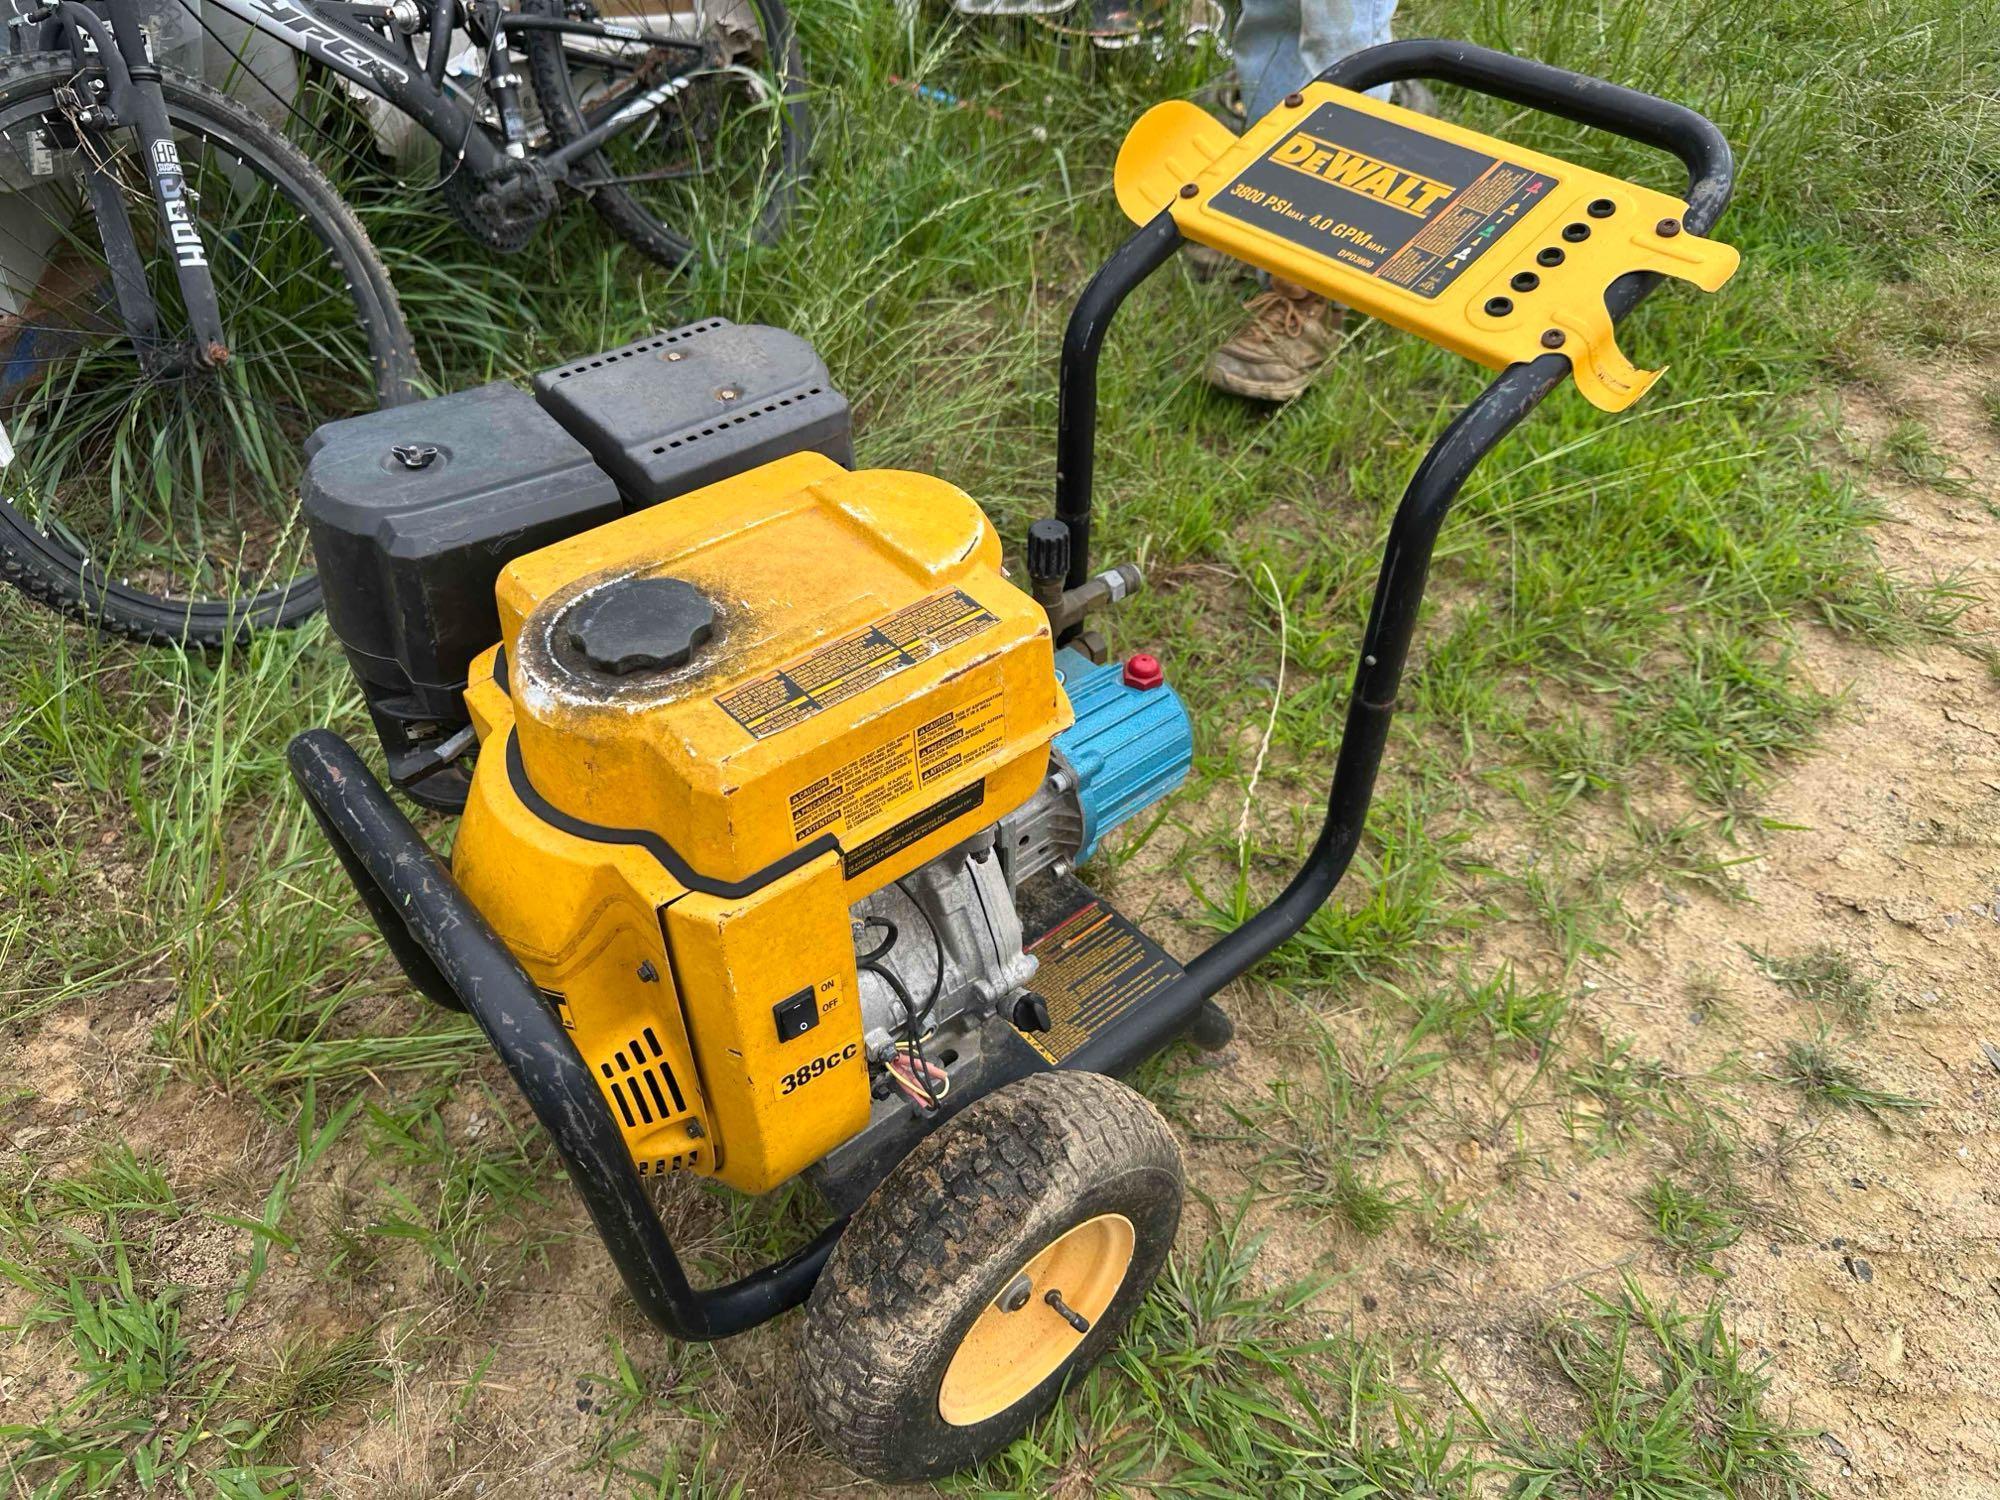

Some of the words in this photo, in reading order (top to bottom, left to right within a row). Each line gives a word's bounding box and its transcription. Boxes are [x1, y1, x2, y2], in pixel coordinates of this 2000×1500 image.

[1274, 138, 1453, 213] DEWALT
[1230, 183, 1265, 204] 3800
[1308, 214, 1334, 231] 4.0
[925, 714, 952, 731] CAUTION
[931, 755, 960, 776] ATTENTION
[799, 778, 828, 799] CAUTION
[805, 811, 840, 836] ATTENTION
[820, 980, 834, 992] ON
[822, 998, 838, 1012] OFF
[781, 1044, 856, 1095] 389cc
